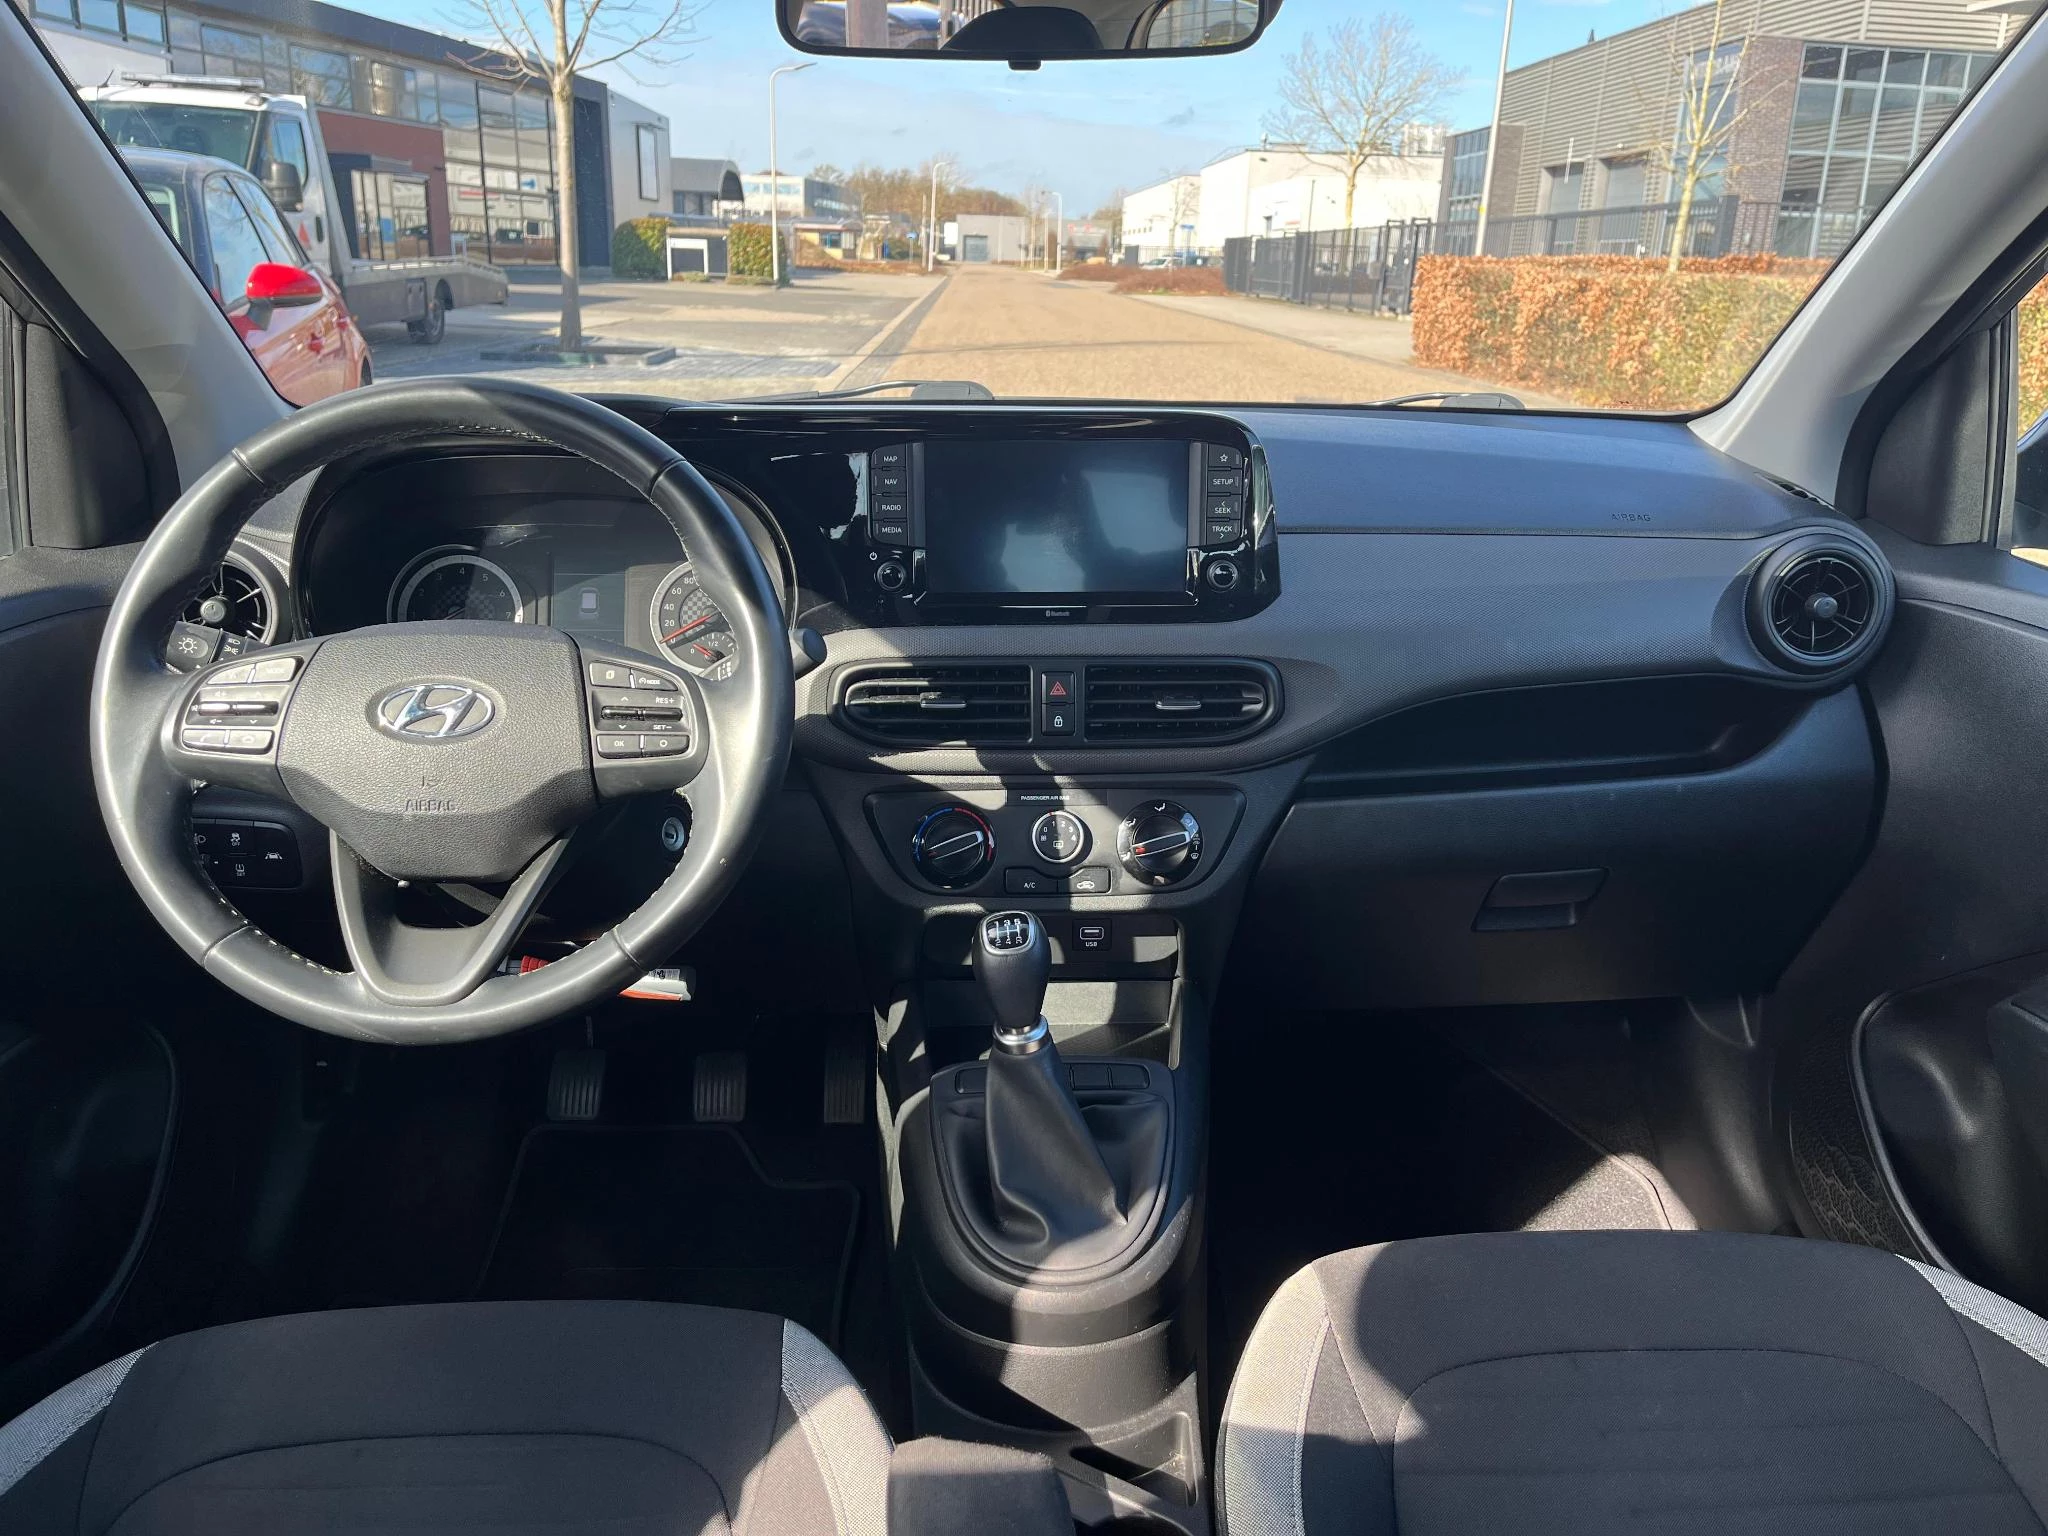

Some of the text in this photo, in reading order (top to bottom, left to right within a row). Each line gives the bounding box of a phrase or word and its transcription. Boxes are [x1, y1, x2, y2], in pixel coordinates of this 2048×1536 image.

[1611, 513, 1651, 522] AIRBAG
[460, 567, 465, 575] 4
[482, 574, 489, 582] 5
[664, 619, 675, 627] 20
[406, 799, 457, 812] AIRBAG
